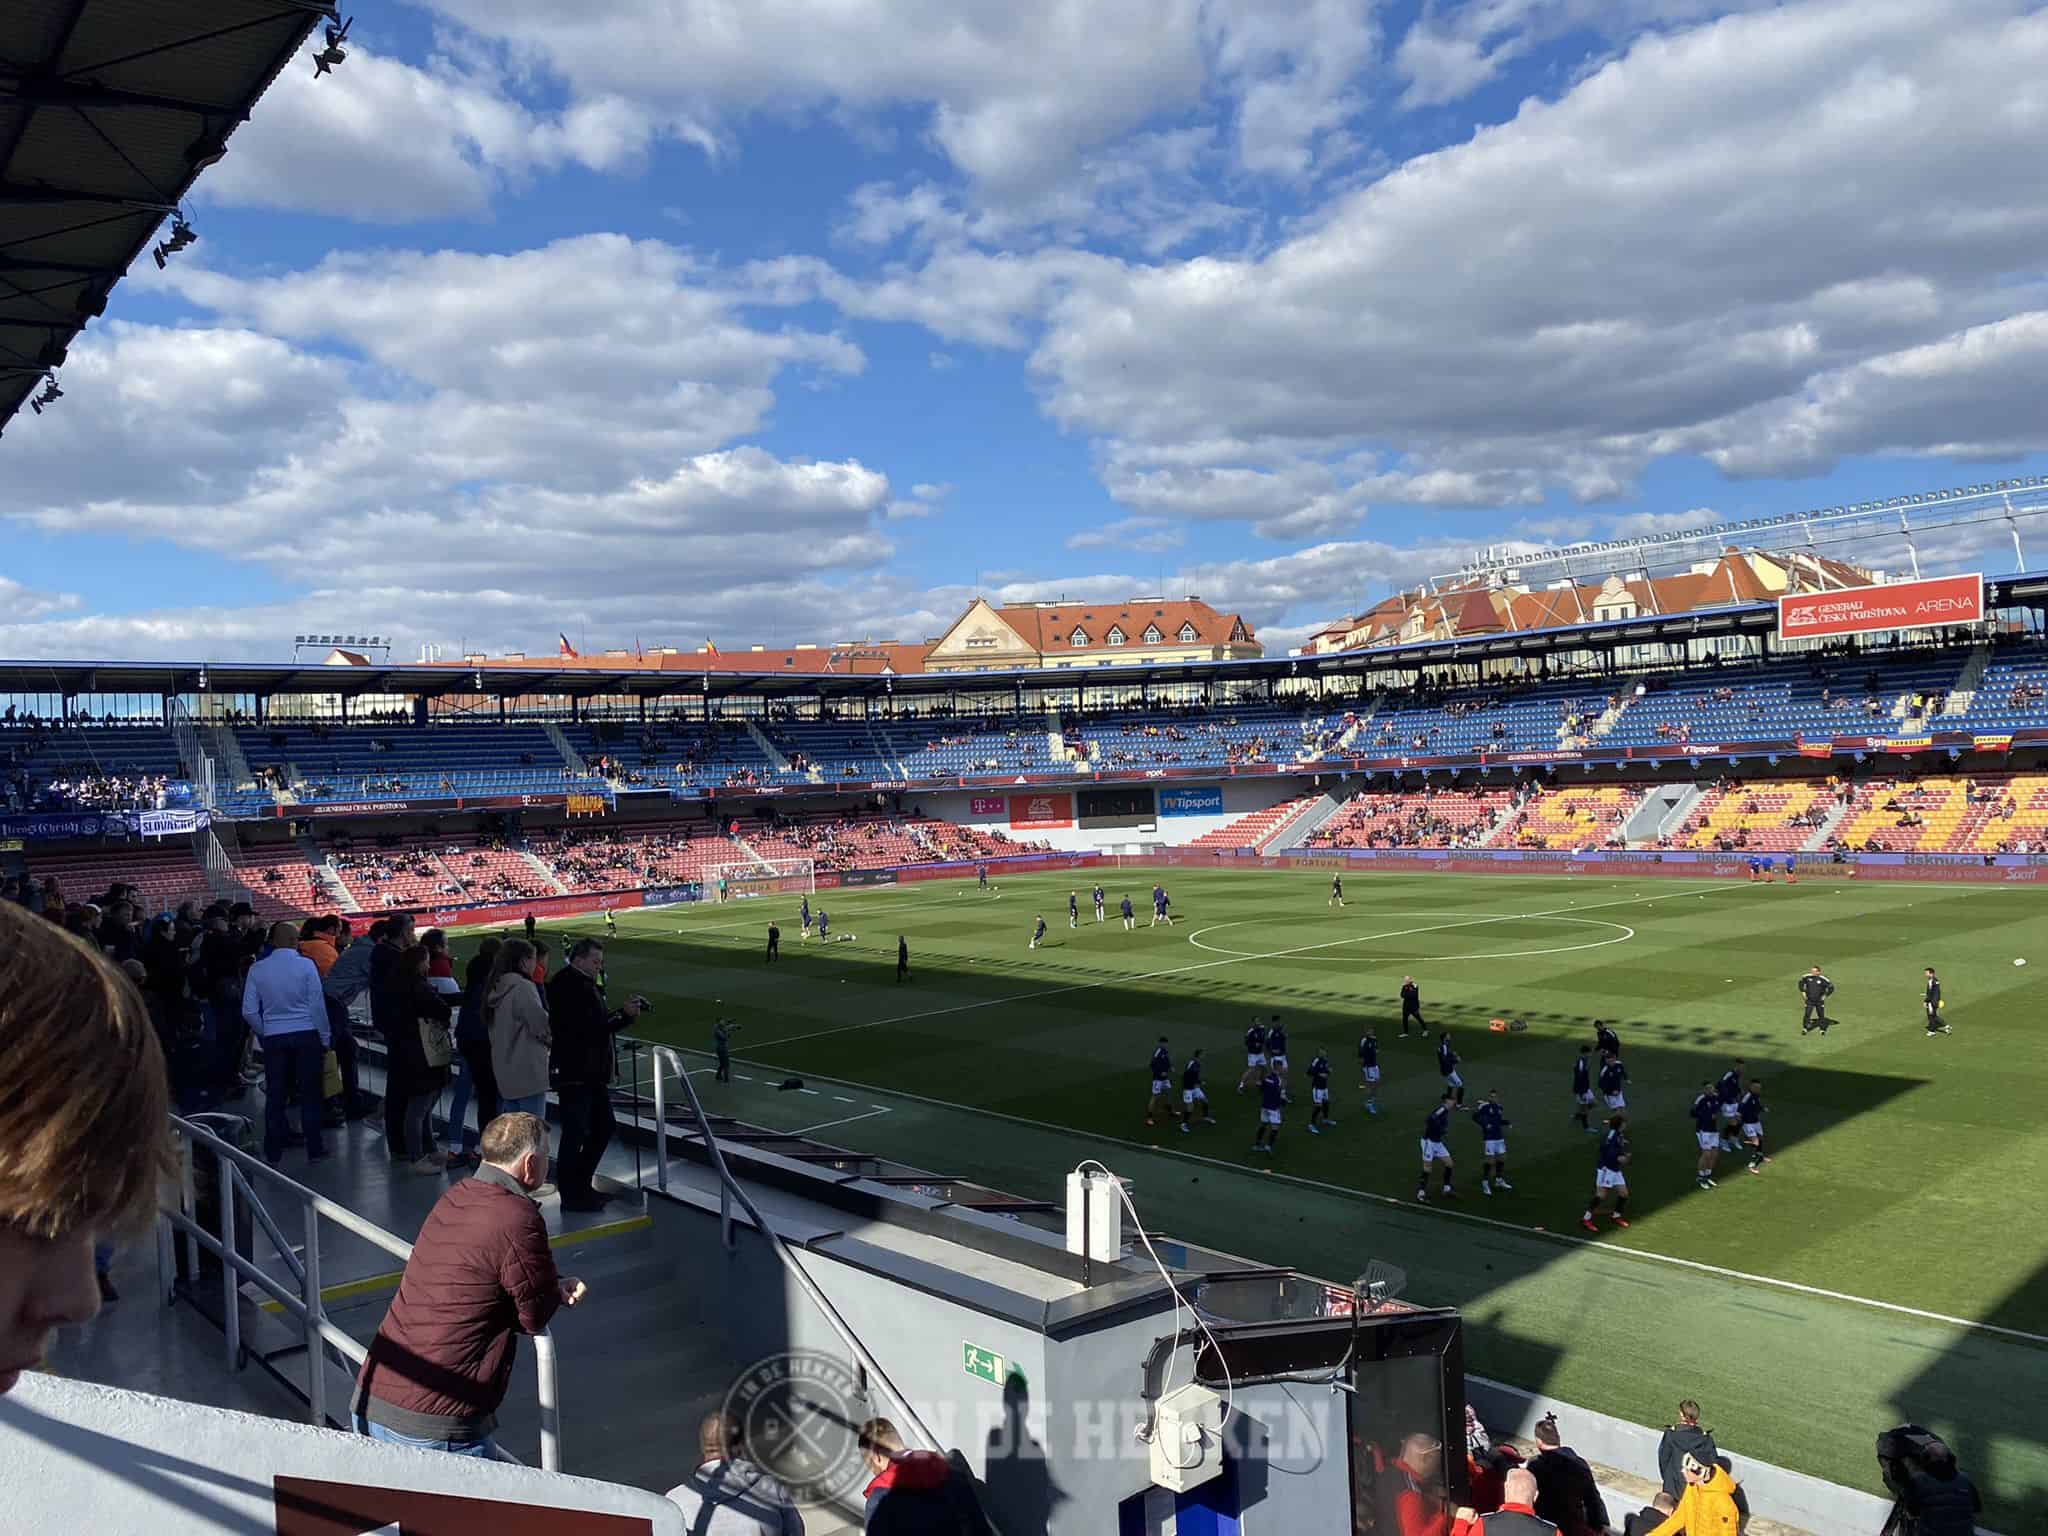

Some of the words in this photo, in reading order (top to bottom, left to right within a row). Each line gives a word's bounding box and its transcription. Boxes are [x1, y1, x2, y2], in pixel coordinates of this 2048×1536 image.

[1818, 600, 1864, 613] GENERALI
[1915, 597, 1974, 613] ARENA
[1690, 744, 1721, 755] Tipsport
[1296, 859, 1339, 868] FORTUNA
[1904, 853, 1980, 866] tisknu.cz
[2006, 867, 2037, 881] Sport
[435, 912, 458, 924] Sport
